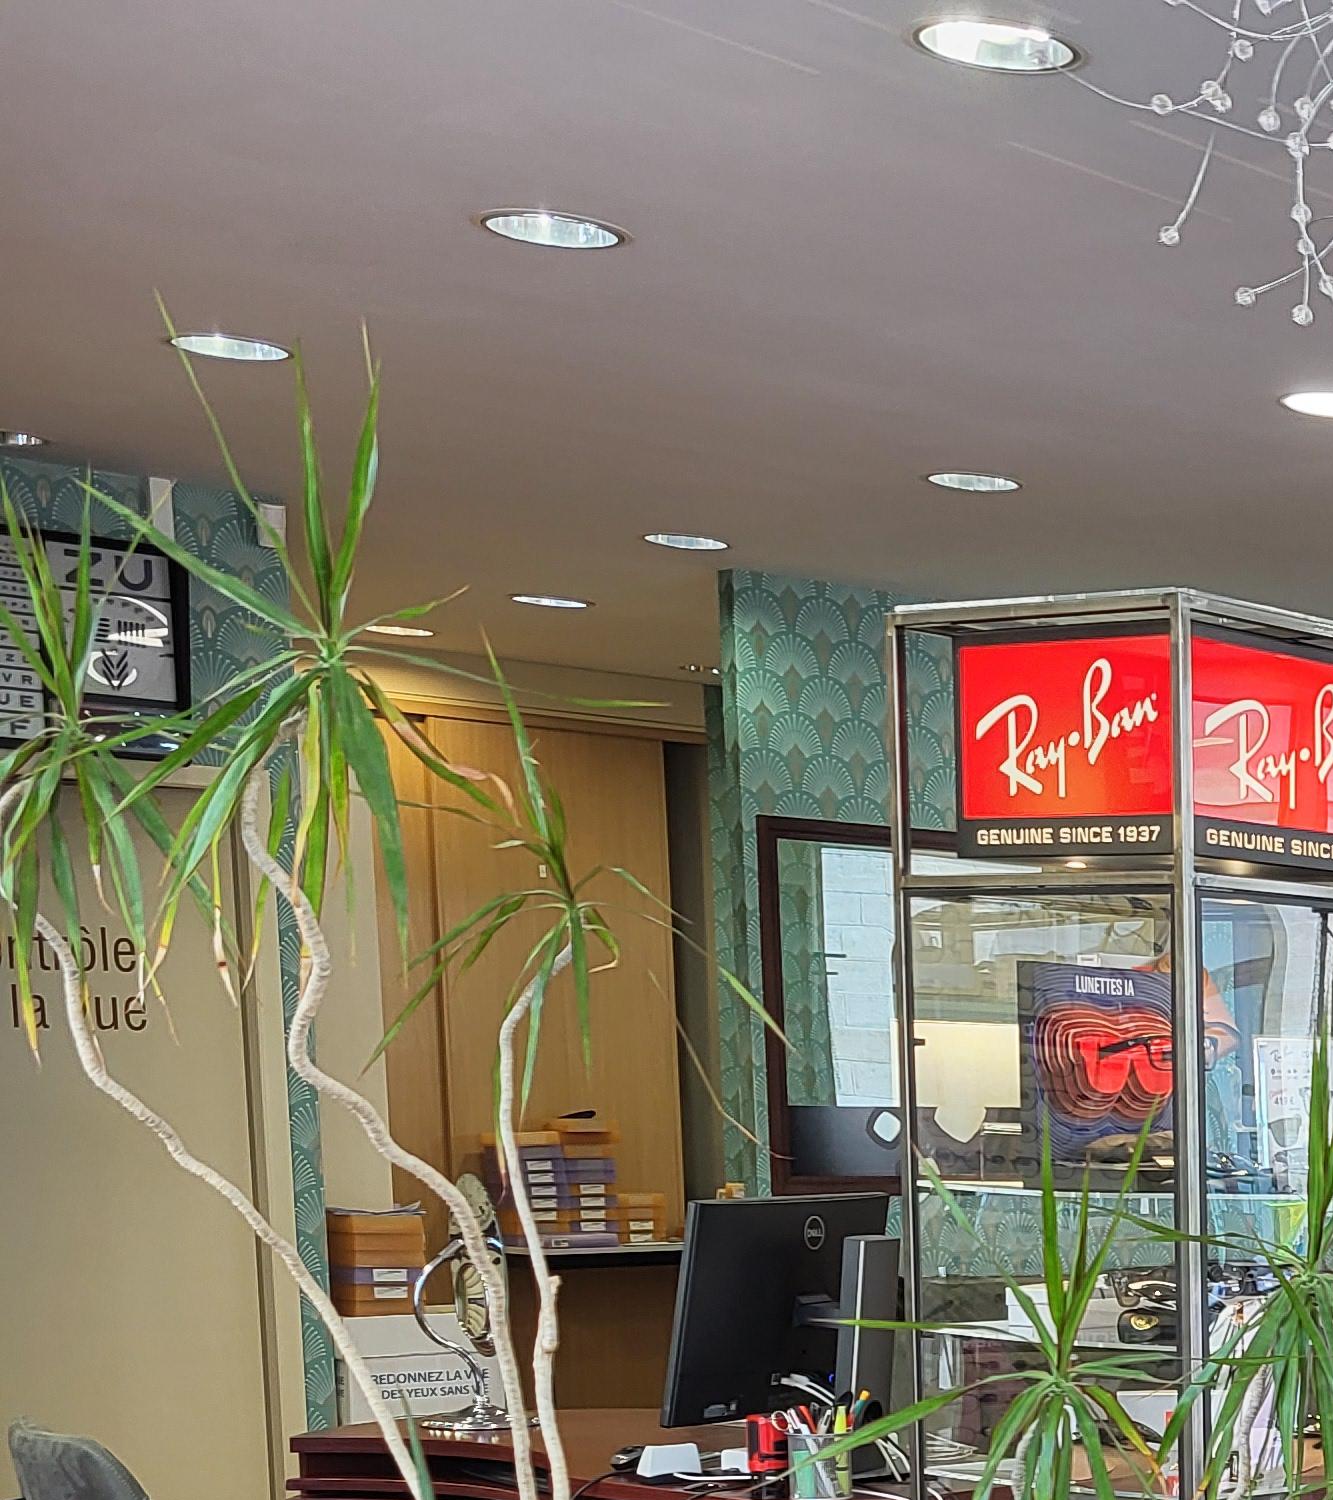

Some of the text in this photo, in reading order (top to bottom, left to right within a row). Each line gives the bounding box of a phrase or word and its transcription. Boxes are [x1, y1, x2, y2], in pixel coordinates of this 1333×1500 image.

[976, 824, 1162, 846] GENUINE SINCE 1937
[1205, 827, 1285, 854] GENUINE
[1075, 974, 1135, 997] LUNETTES IA
[446, 1369, 462, 1381] LA
[406, 1387, 438, 1399] YEUX
[440, 1384, 469, 1395] SANS
